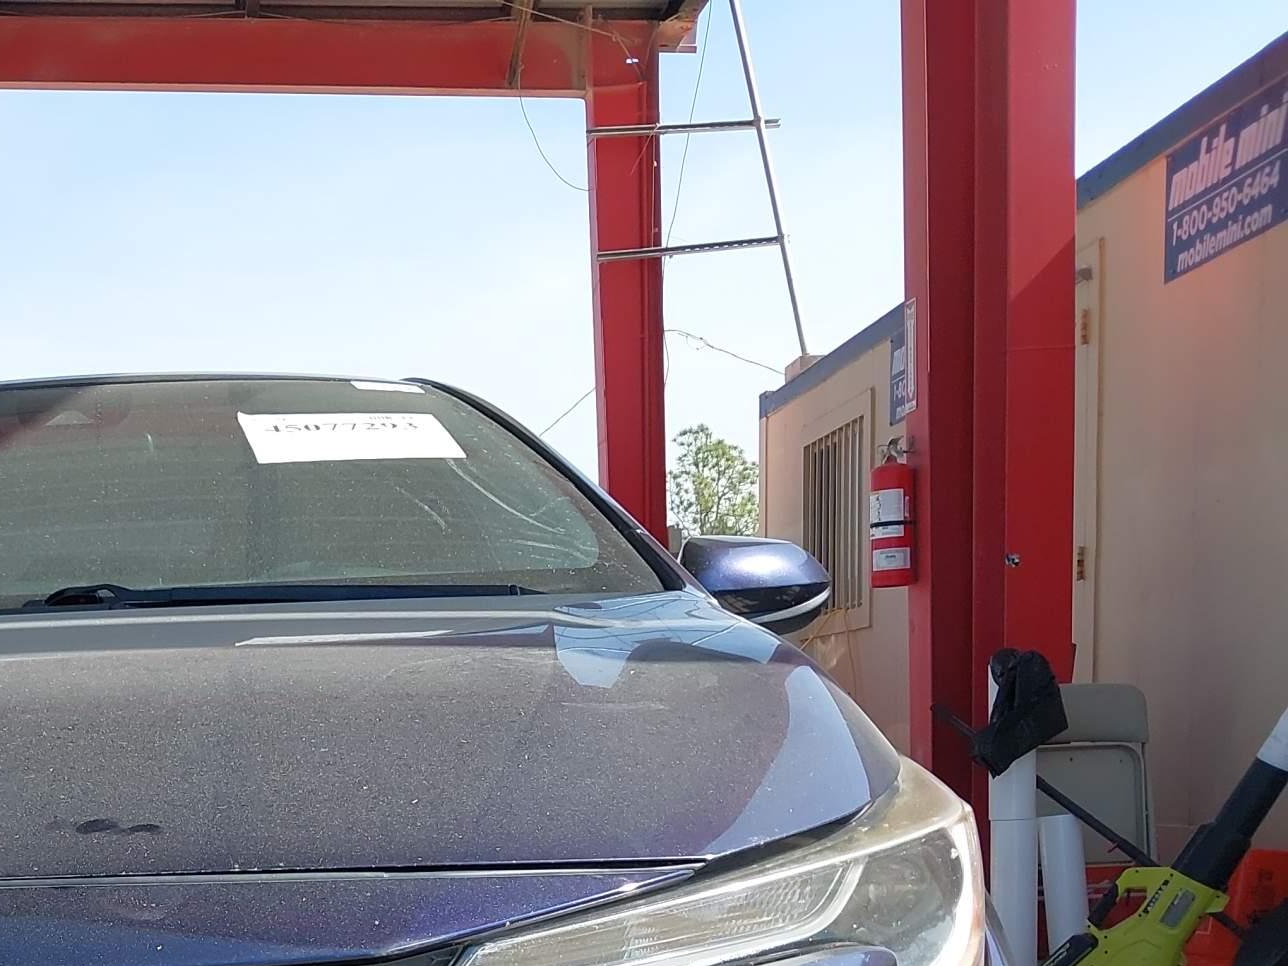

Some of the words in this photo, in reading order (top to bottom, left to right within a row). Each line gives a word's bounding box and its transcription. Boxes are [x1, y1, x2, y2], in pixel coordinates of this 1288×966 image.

[1168, 123, 1236, 211] mobile
[1172, 159, 1281, 246] 1-800-950-6464
[1177, 203, 1273, 273] mobilemini.com
